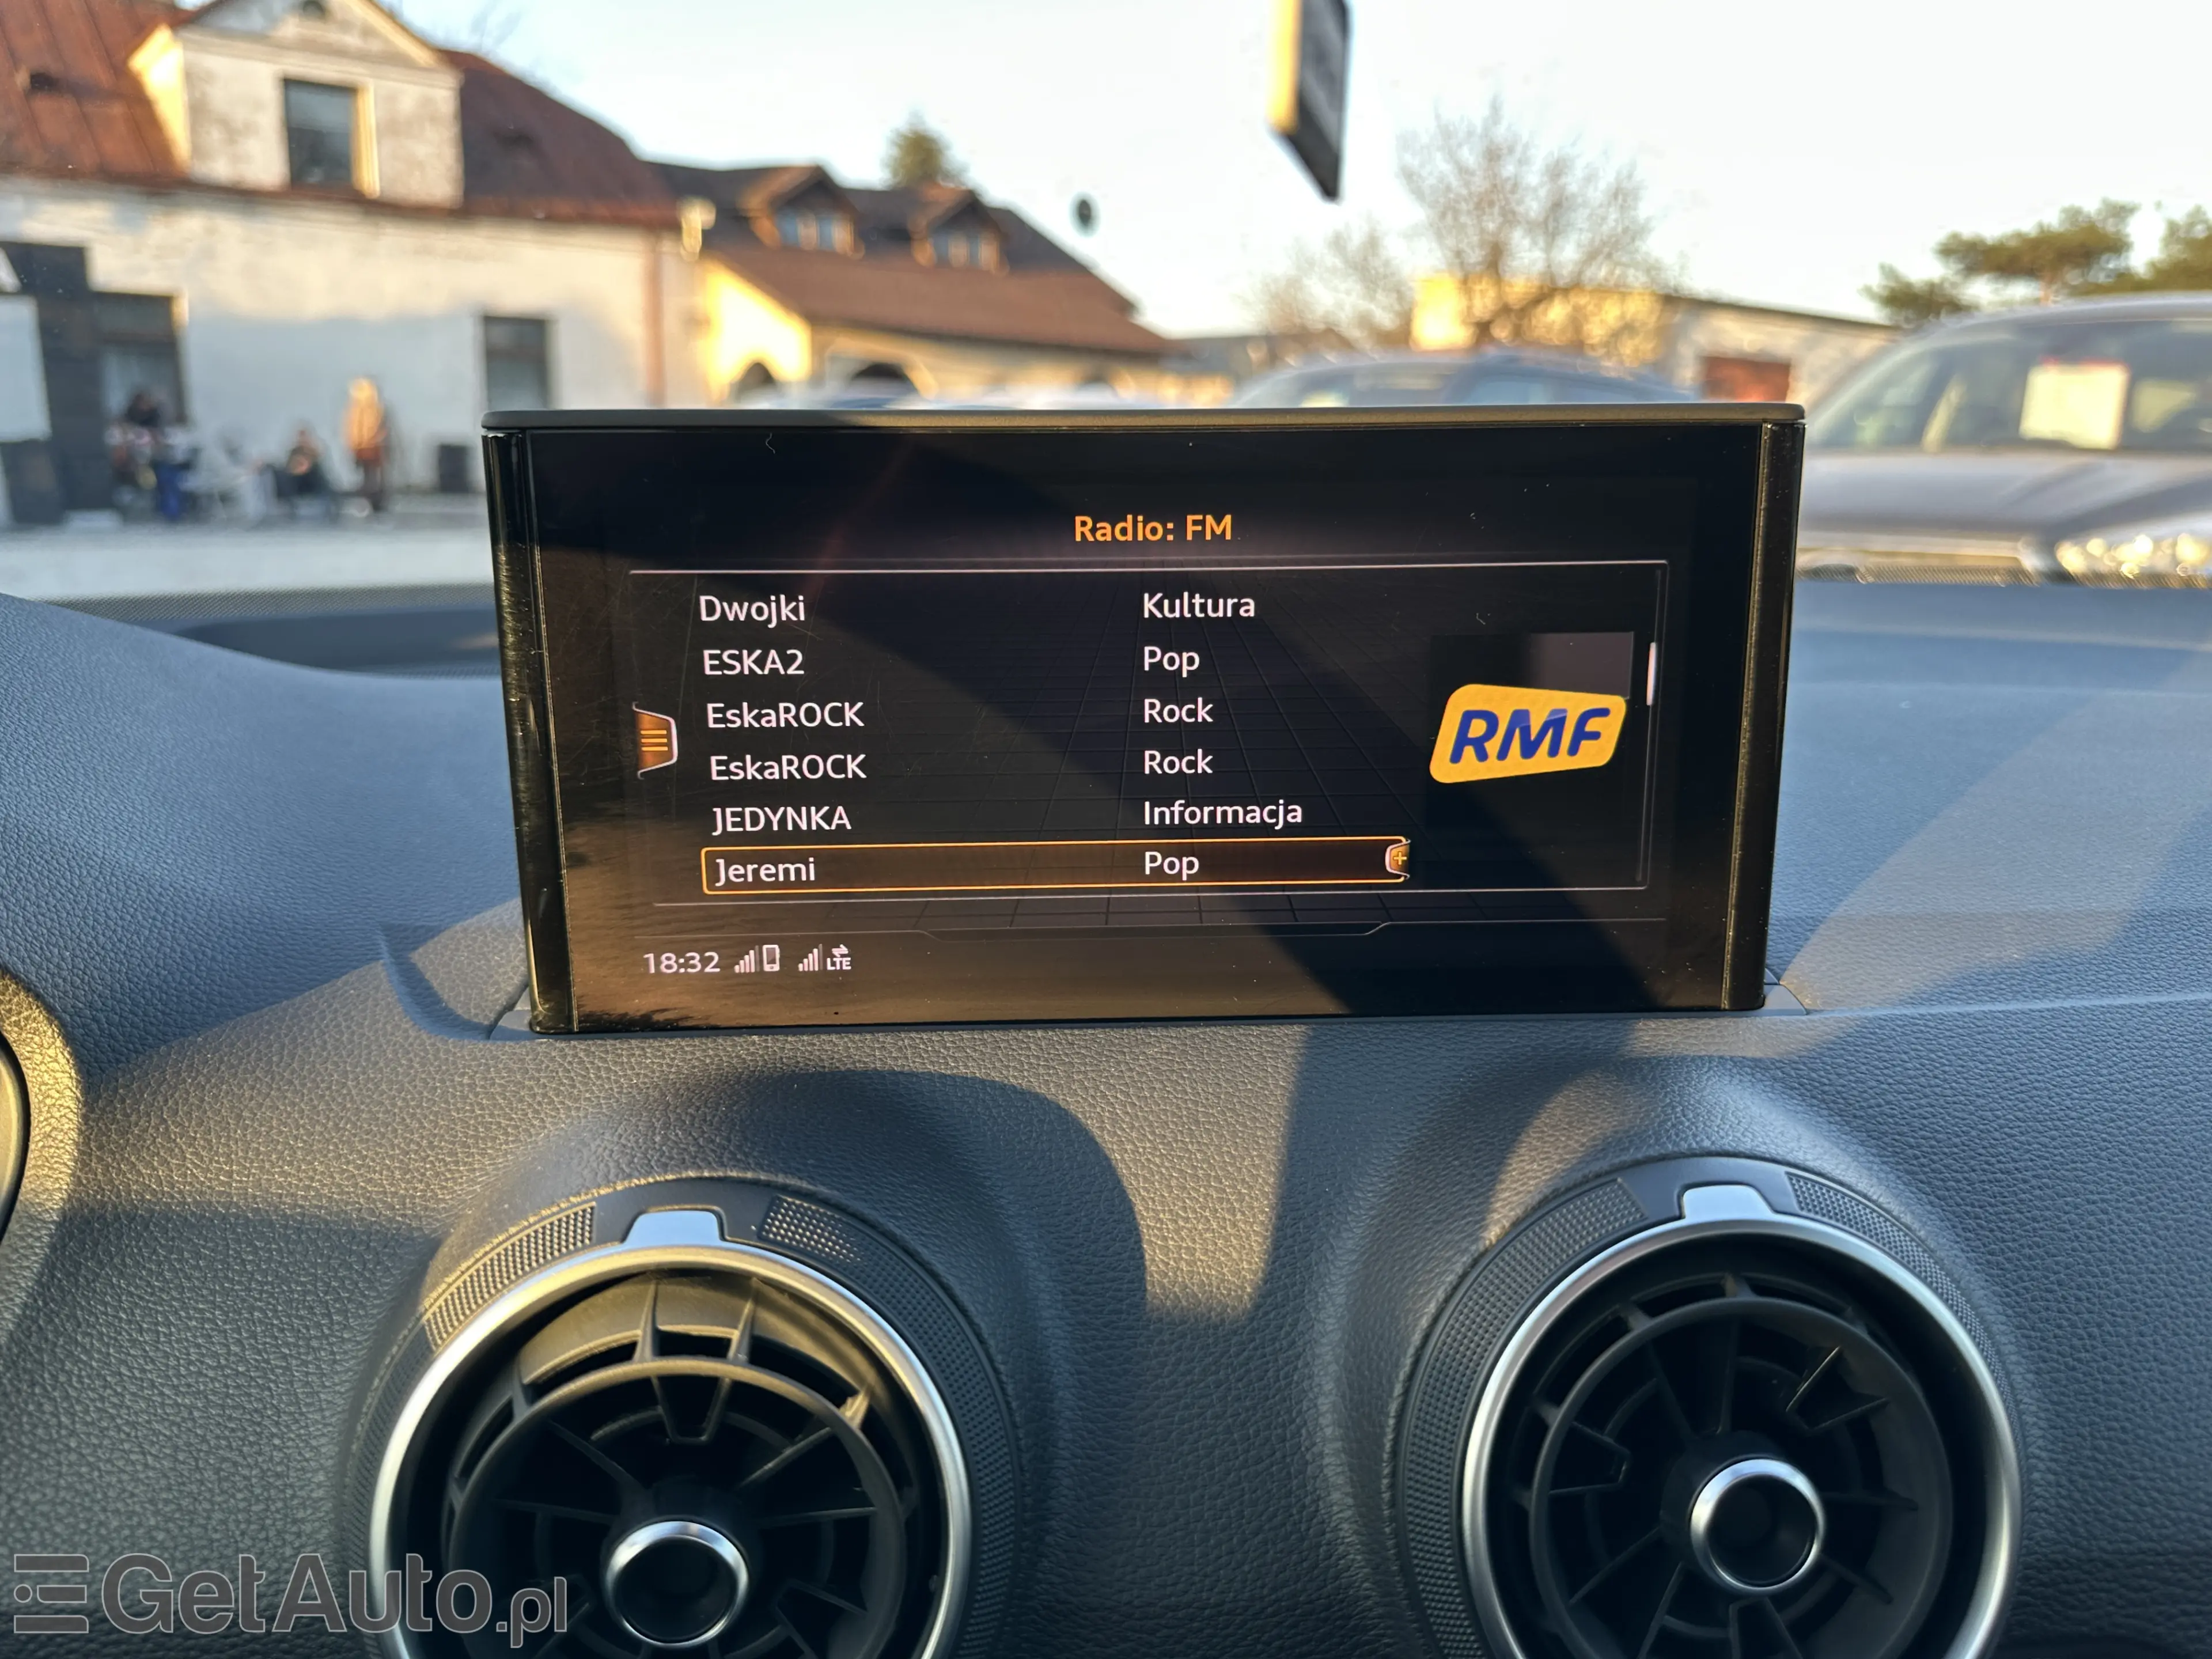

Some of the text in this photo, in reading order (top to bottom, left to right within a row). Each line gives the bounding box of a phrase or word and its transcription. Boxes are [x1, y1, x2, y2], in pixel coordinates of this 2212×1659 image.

[1074, 514, 1233, 543] Radio: FM
[699, 594, 806, 629] Dwojki
[1142, 592, 1256, 619] Kultura
[703, 649, 805, 676] ESKA2
[1143, 646, 1200, 678] Pop
[706, 701, 865, 729] EskaROCK
[1143, 697, 1214, 724] Rock
[1448, 707, 1611, 764] RMF
[710, 753, 867, 781] EskaROCK
[1143, 748, 1214, 775] Rock
[711, 806, 852, 836] JEDYNKA
[1143, 798, 1303, 830] Informacja
[714, 857, 816, 887] Jeremi
[1143, 851, 1200, 881] Pop
[643, 951, 721, 974] 18:32
[826, 957, 852, 971] LTE
